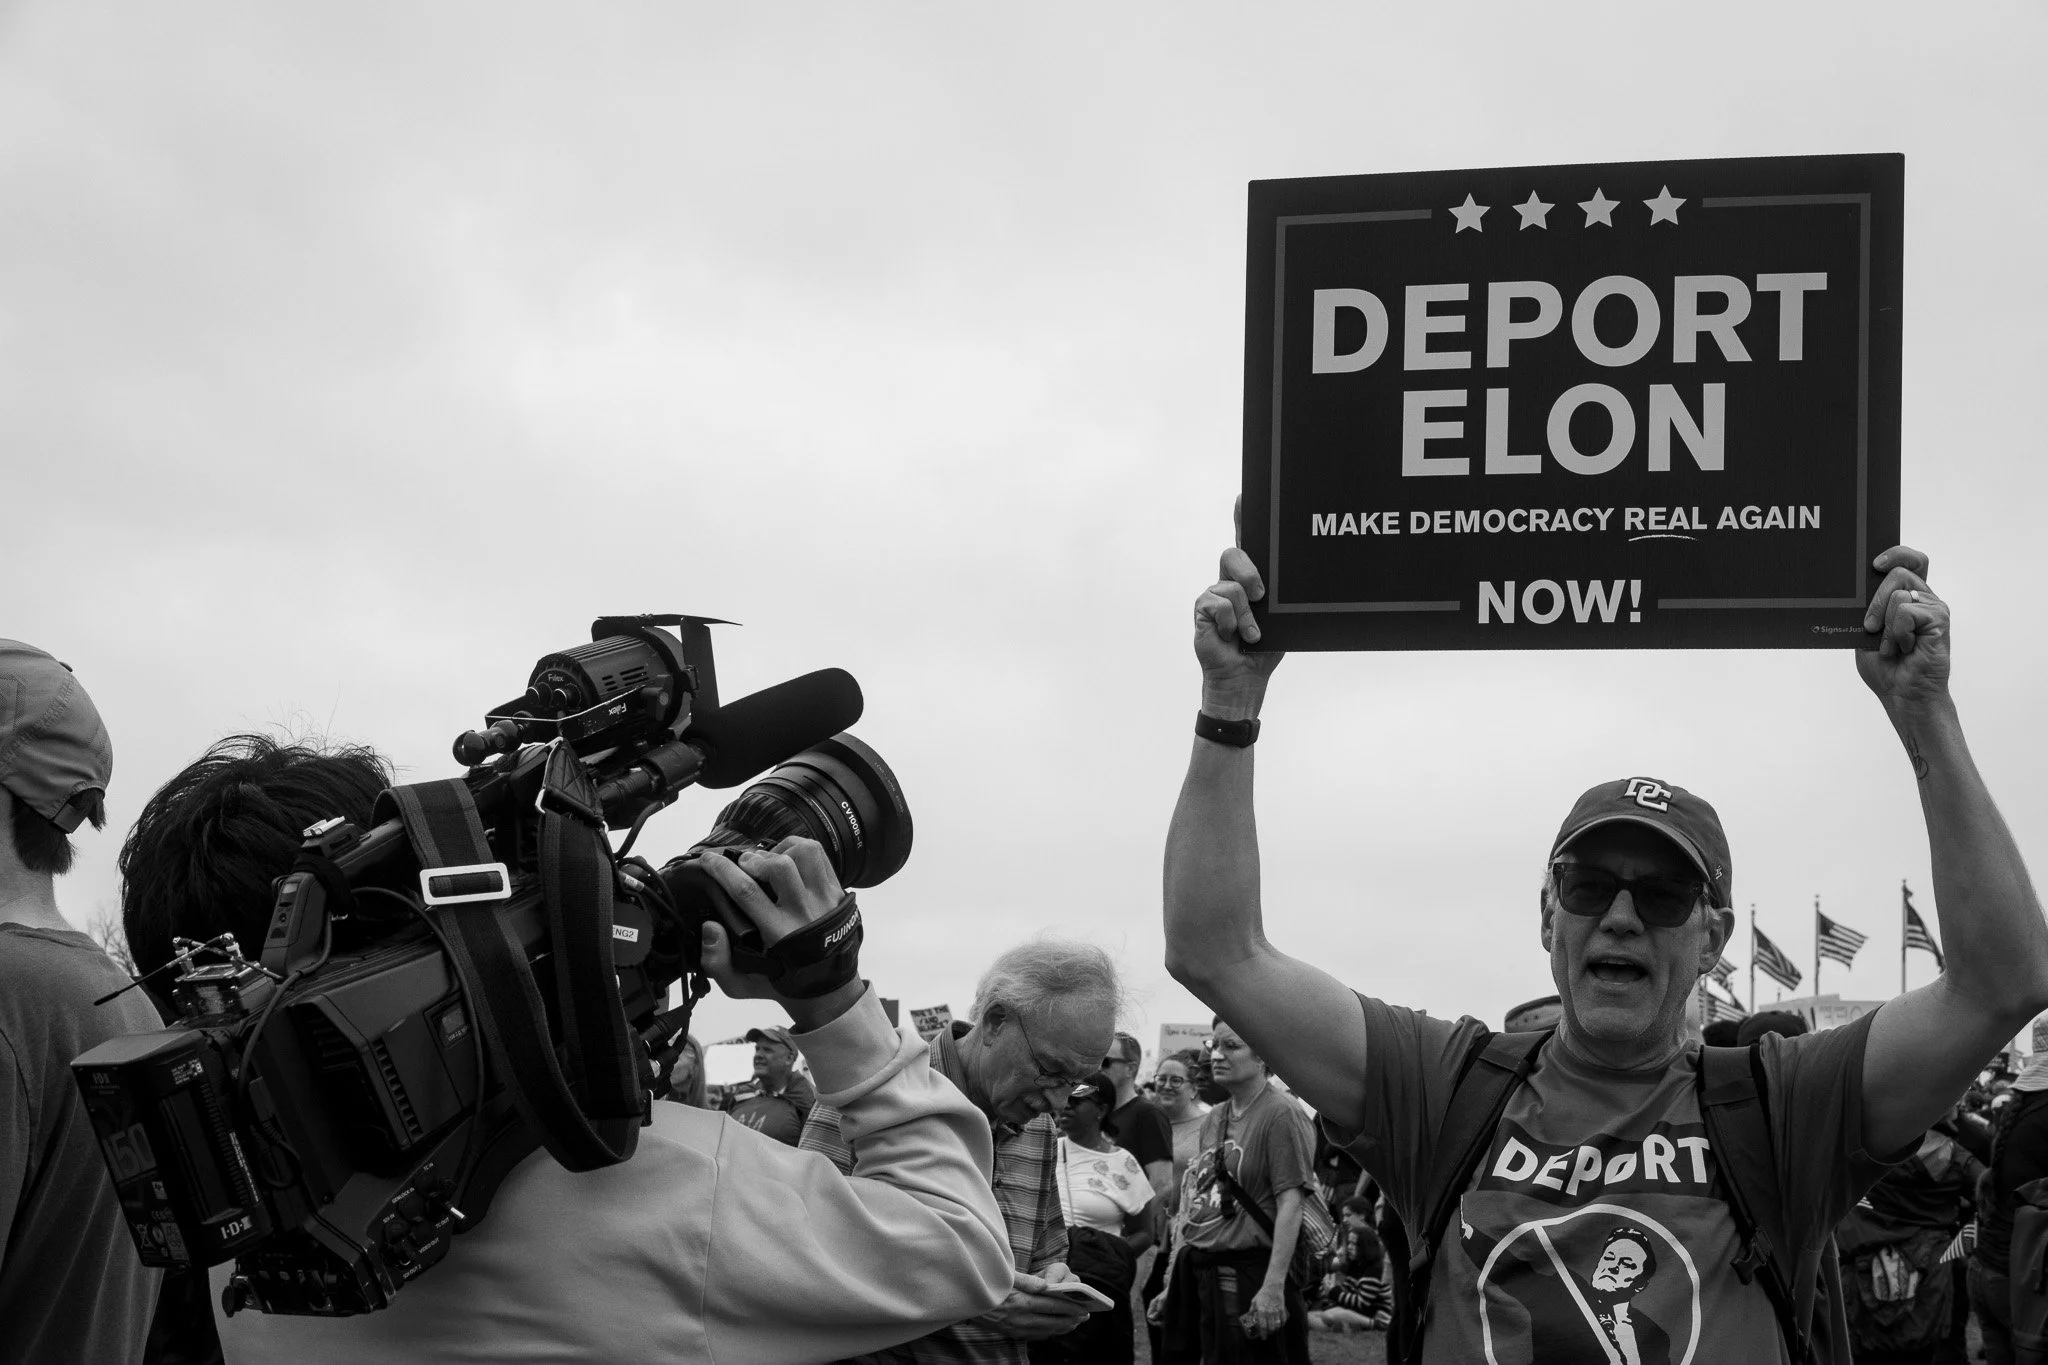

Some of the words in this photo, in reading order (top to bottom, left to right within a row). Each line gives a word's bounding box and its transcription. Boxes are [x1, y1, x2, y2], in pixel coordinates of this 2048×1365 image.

[1312, 272, 1828, 374] DEPORT
[1401, 382, 1726, 477] ELON
[1311, 511, 1401, 537] MAKE
[1409, 507, 1615, 534] DEMOCRACY
[1624, 506, 1707, 531] REAL
[1716, 505, 1821, 530] AGAIN
[1478, 579, 1642, 625] NOW!
[1624, 778, 1672, 812] DC
[1491, 1133, 1711, 1196] DEPORT
